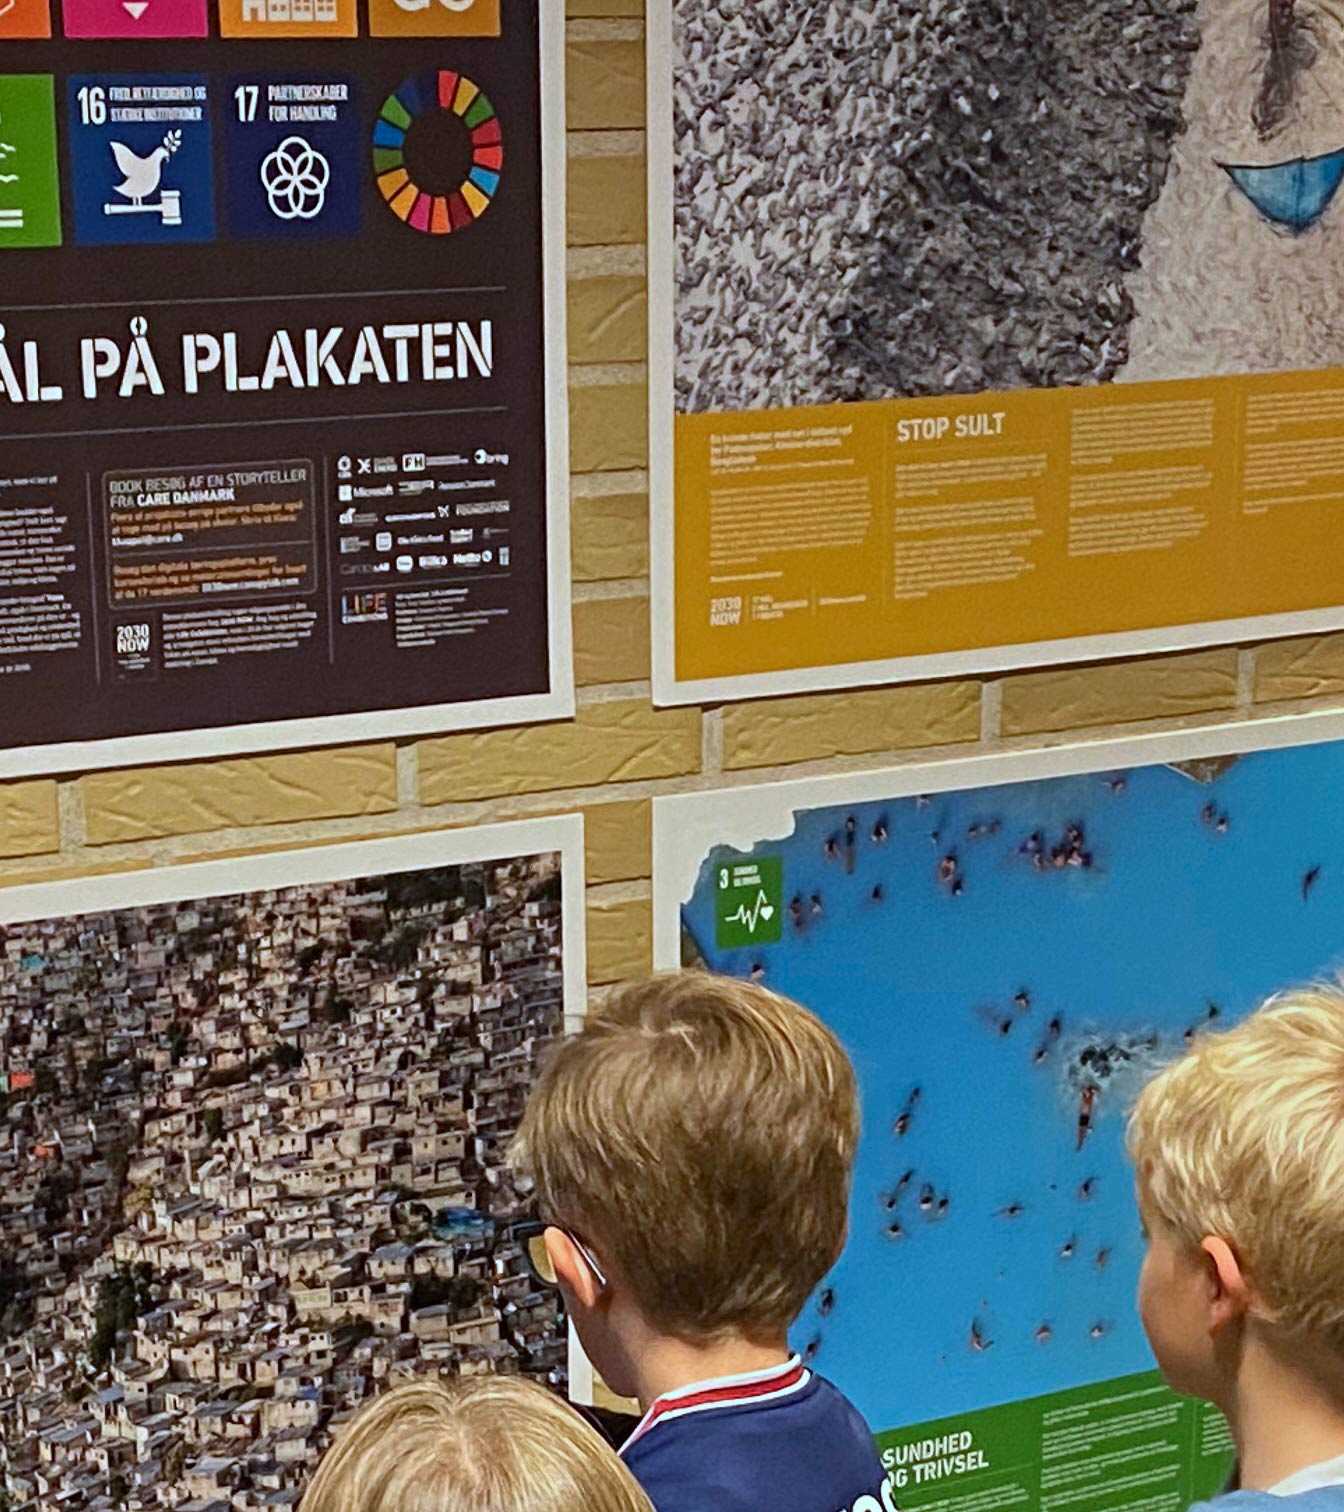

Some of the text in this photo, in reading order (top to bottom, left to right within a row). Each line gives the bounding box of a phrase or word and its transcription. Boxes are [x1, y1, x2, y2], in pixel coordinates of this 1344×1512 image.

[76, 86, 107, 125] 16
[234, 86, 259, 122] 17
[81, 316, 166, 398] PÅ
[182, 320, 494, 395] PLAKATEN
[897, 412, 1007, 443] STOP SULT
[189, 475, 205, 489] AF
[227, 468, 307, 487] STORYTELLER
[111, 488, 236, 508] FRA CARE DANMARK
[710, 596, 742, 613] 2030
[710, 611, 741, 627] NOW
[117, 622, 150, 639] 2030
[117, 638, 150, 654] NOW
[720, 868, 729, 889] 3
[880, 1430, 973, 1470] SUNDHED
[912, 1449, 990, 1484] TRIVSEL
